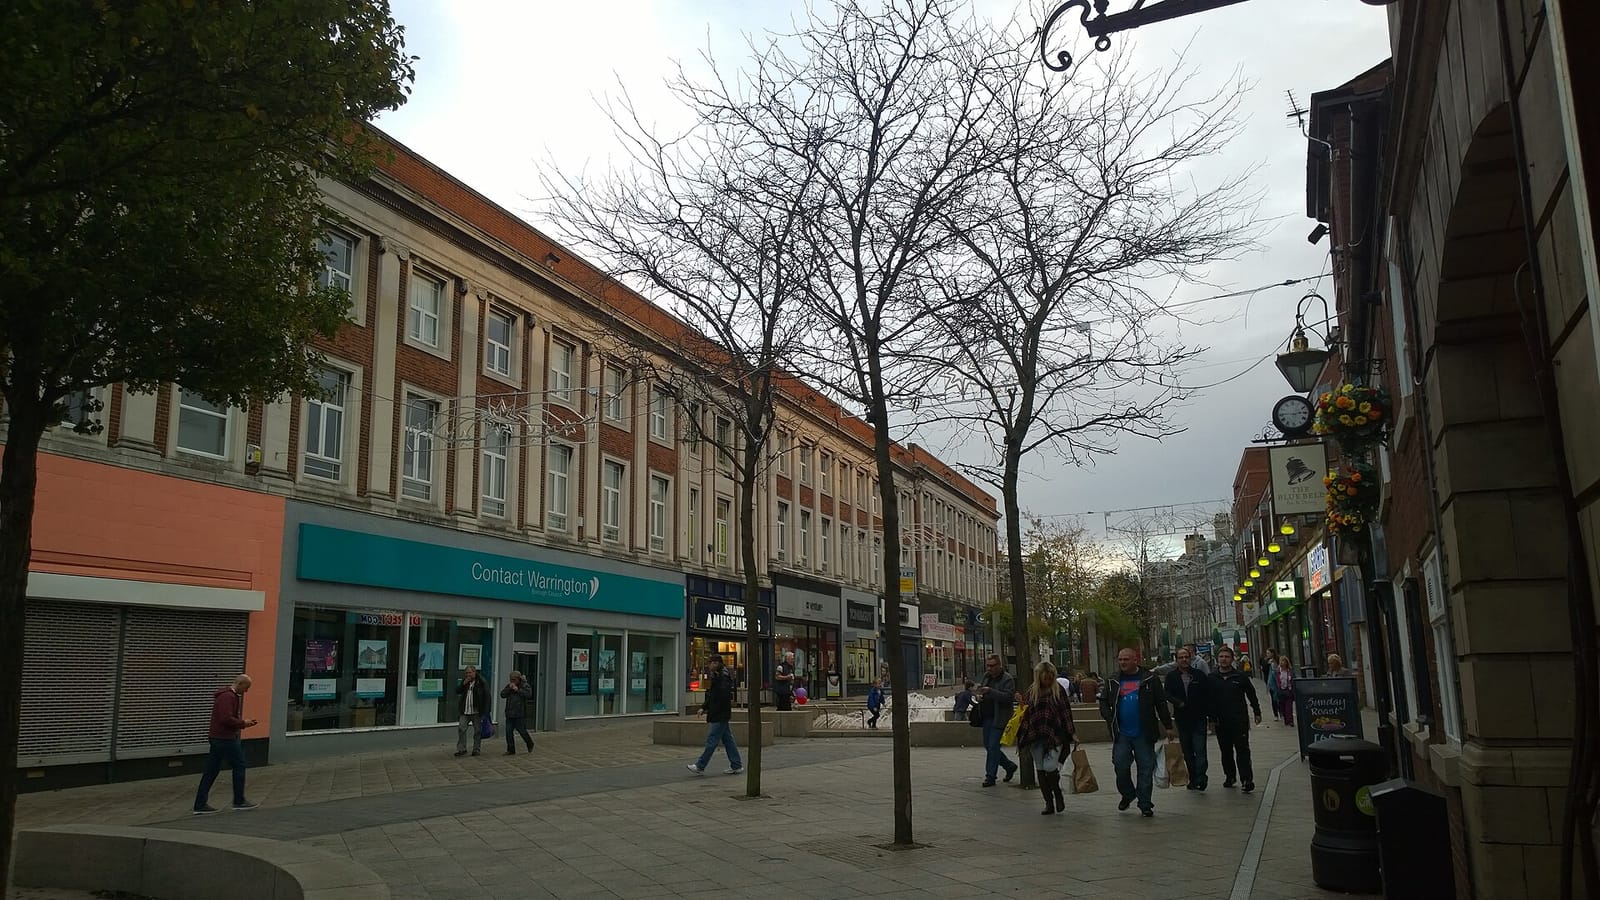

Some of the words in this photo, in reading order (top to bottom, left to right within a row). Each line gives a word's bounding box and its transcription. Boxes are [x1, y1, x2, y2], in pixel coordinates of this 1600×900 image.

[471, 562, 525, 587] Contact
[527, 570, 589, 597] Warrington
[724, 603, 746, 617] SHAWS
[706, 612, 761, 633] AMUSEMES
[1308, 697, 1346, 711] Sunday
[1311, 707, 1341, 716] Roast
